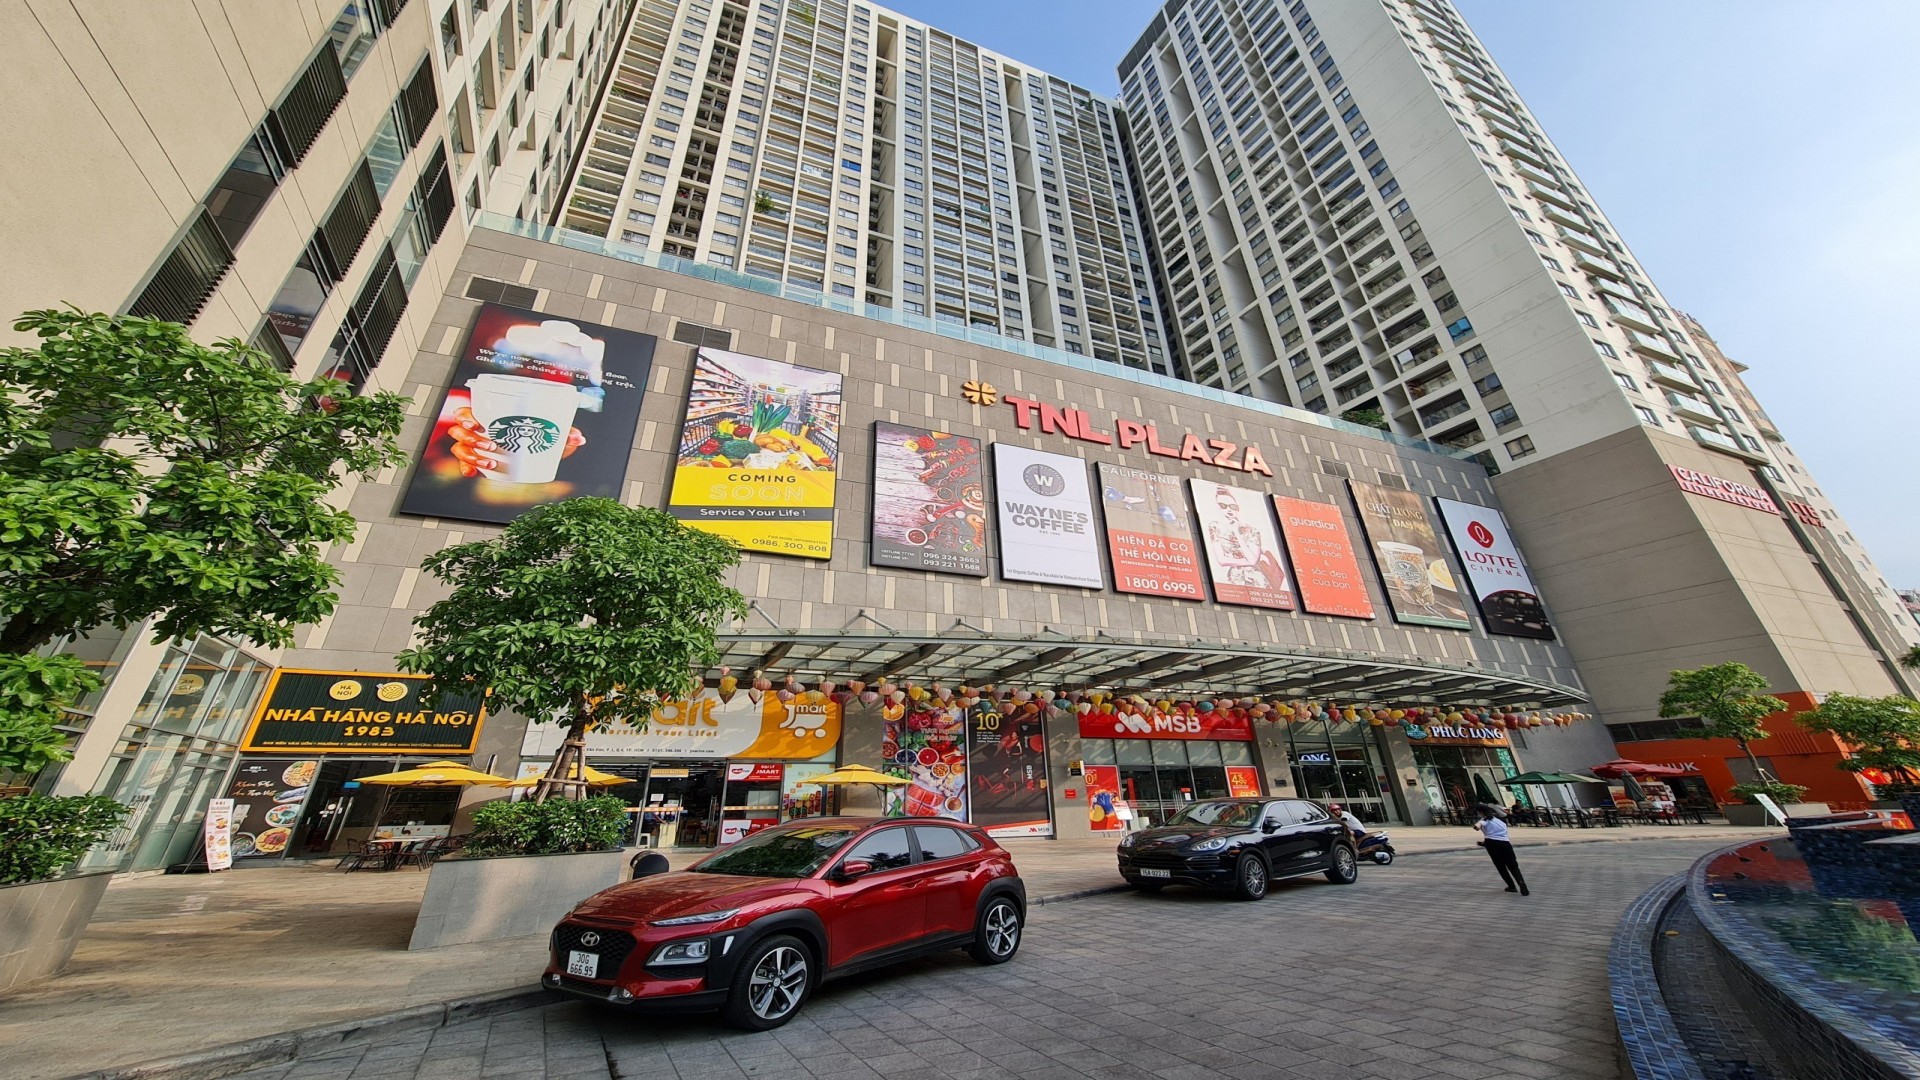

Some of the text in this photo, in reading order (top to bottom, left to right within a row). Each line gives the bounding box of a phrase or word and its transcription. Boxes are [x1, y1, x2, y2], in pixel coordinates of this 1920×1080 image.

[511, 354, 531, 362] now
[527, 364, 557, 376] chúng
[1004, 394, 1274, 477] TNL PLAZA
[728, 473, 797, 483] COMING
[1033, 473, 1054, 487] W
[1100, 465, 1179, 485] CALIFORNIA
[1676, 465, 1770, 503] CALIFORNIA
[709, 484, 805, 501] SOON
[700, 508, 745, 517] Service
[748, 509, 776, 518] Your
[779, 509, 800, 518] Life
[1005, 501, 1089, 524] WAYNE'S
[1012, 514, 1085, 535] COFFEE
[1289, 516, 1338, 531] guardian
[1116, 534, 1145, 547] HIỆN
[808, 544, 828, 553] 808
[923, 559, 940, 567] 093
[941, 554, 957, 562] 324
[1142, 550, 1164, 563] HỘI
[1165, 553, 1191, 565] VIÊN
[1464, 550, 1518, 569] LOTTE
[1470, 564, 1523, 578] CINEMA
[1125, 576, 1196, 594] 1800 6995
[265, 707, 325, 722] NHÀ
[322, 708, 391, 723] HÀNG
[395, 710, 433, 724] HÀ
[779, 703, 828, 729] Jmart
[1154, 714, 1201, 733] MSB
[344, 726, 395, 737] 1983
[656, 729, 683, 737] Your
[1469, 727, 1504, 739] LONG
[1026, 764, 1034, 780] MSB
[577, 953, 590, 964] 30G
[570, 963, 593, 977] 666.95
